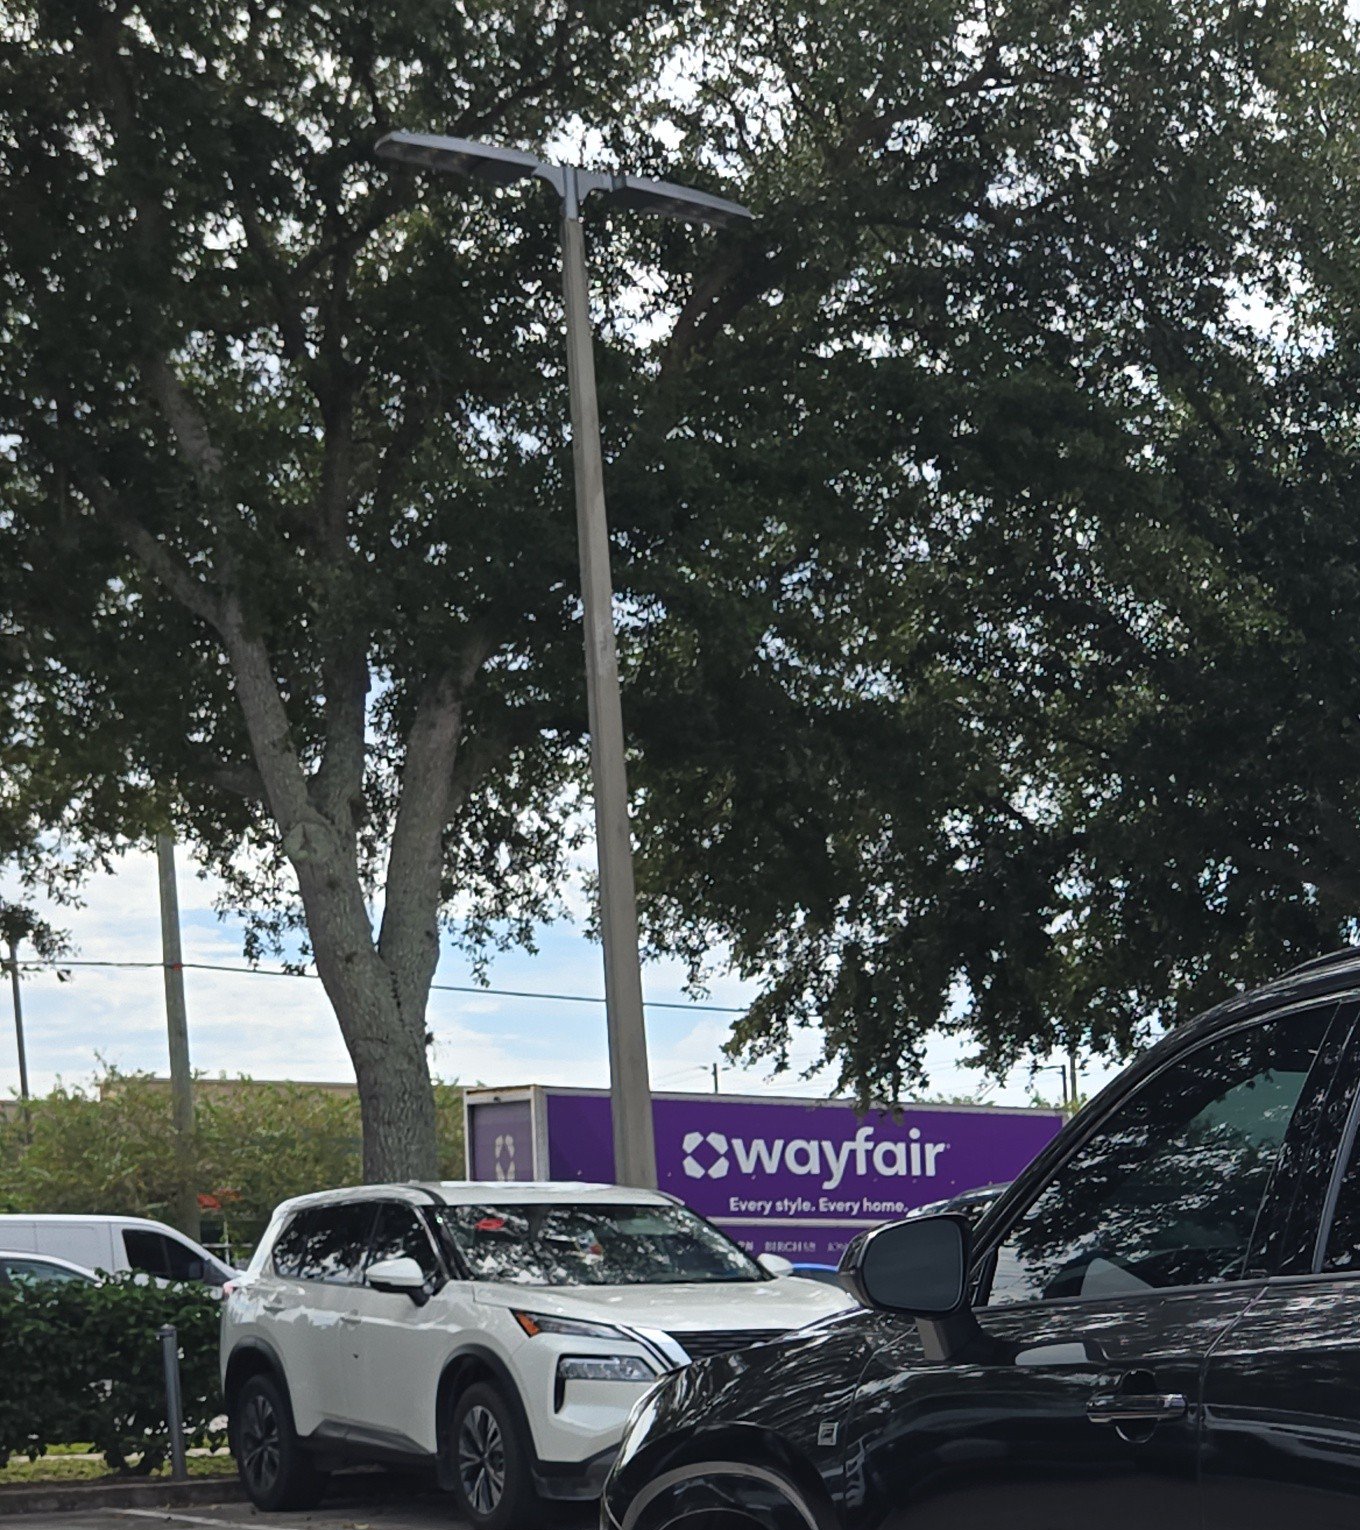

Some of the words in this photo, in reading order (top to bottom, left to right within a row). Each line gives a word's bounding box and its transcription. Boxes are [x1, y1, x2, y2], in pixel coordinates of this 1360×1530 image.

[731, 1126, 945, 1190] wayfair
[729, 1197, 772, 1215] Every
[775, 1197, 816, 1215] style.
[818, 1197, 861, 1215] Every
[862, 1197, 909, 1213] home.
